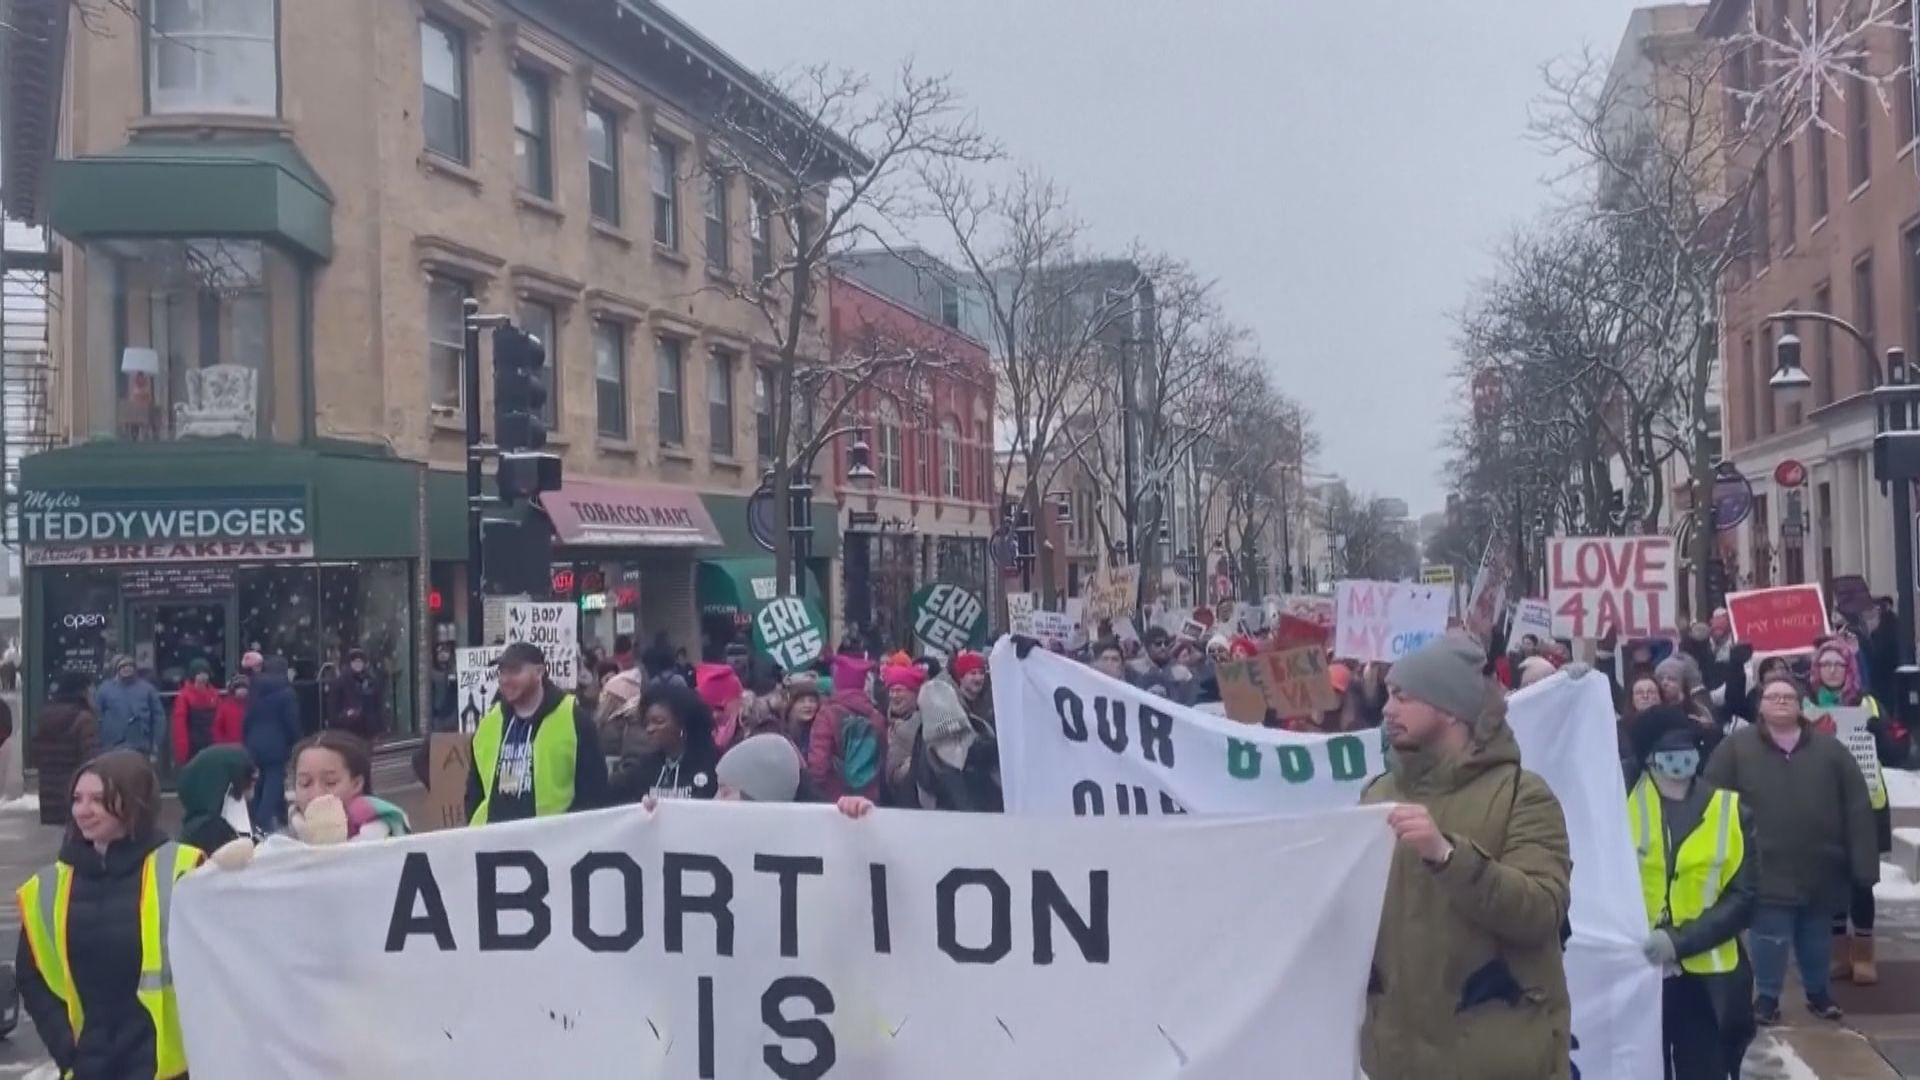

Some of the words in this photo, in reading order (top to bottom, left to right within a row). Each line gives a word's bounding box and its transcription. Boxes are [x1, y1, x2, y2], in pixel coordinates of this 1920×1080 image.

[24, 490, 80, 509] Myles
[570, 501, 649, 525] TOBACCO
[650, 508, 693, 527] MART
[92, 540, 305, 560] BREAKFAST
[1553, 540, 1669, 589] LOVE
[64, 614, 105, 630] open
[532, 606, 563, 623] BODY
[757, 597, 811, 644] ERA
[925, 584, 983, 630] ERA
[1347, 585, 1393, 617] MY
[1556, 592, 1588, 637] 4
[1595, 590, 1679, 637] ALL
[530, 626, 560, 643] SOUL
[766, 627, 822, 671] YES
[914, 606, 971, 654] YES
[1053, 686, 1175, 769] OUR
[383, 850, 1110, 965] ABORTION
[697, 975, 836, 1080] IS
